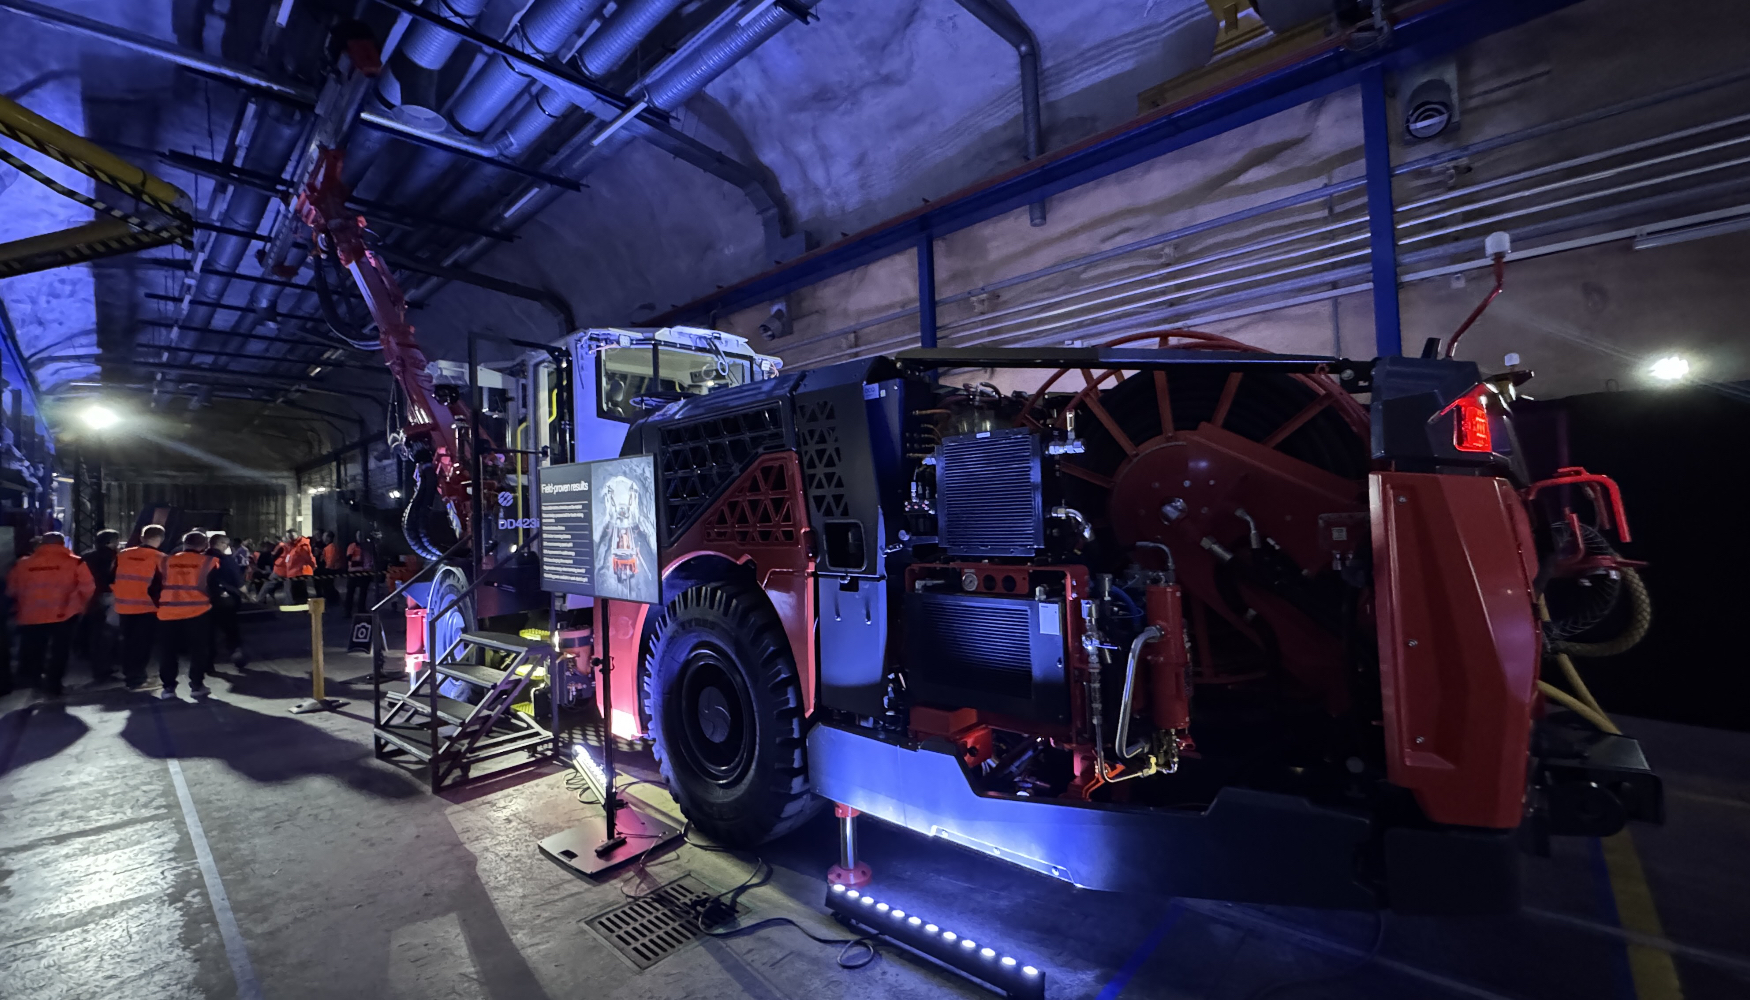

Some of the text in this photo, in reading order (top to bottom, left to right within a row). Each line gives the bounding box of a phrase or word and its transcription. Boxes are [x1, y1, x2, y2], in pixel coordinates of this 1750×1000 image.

[541, 480, 589, 495] Field-proven results
[498, 518, 540, 530] DD423i
